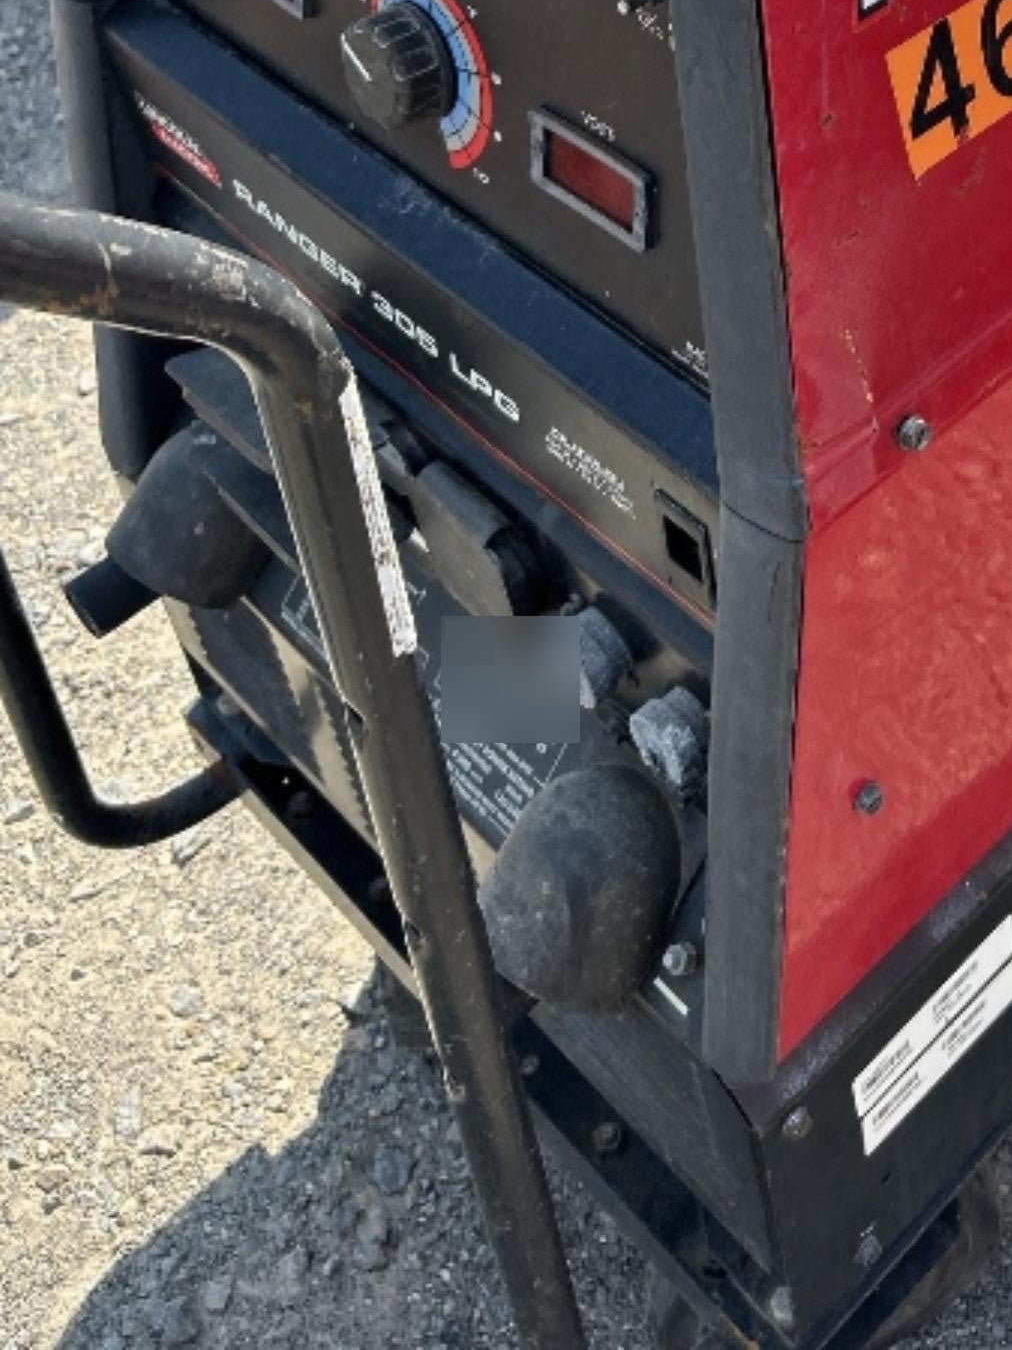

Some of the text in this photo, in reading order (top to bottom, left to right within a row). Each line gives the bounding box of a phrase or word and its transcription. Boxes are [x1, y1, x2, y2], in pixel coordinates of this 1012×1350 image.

[232, 178, 520, 423] RANGER 305 LPG
